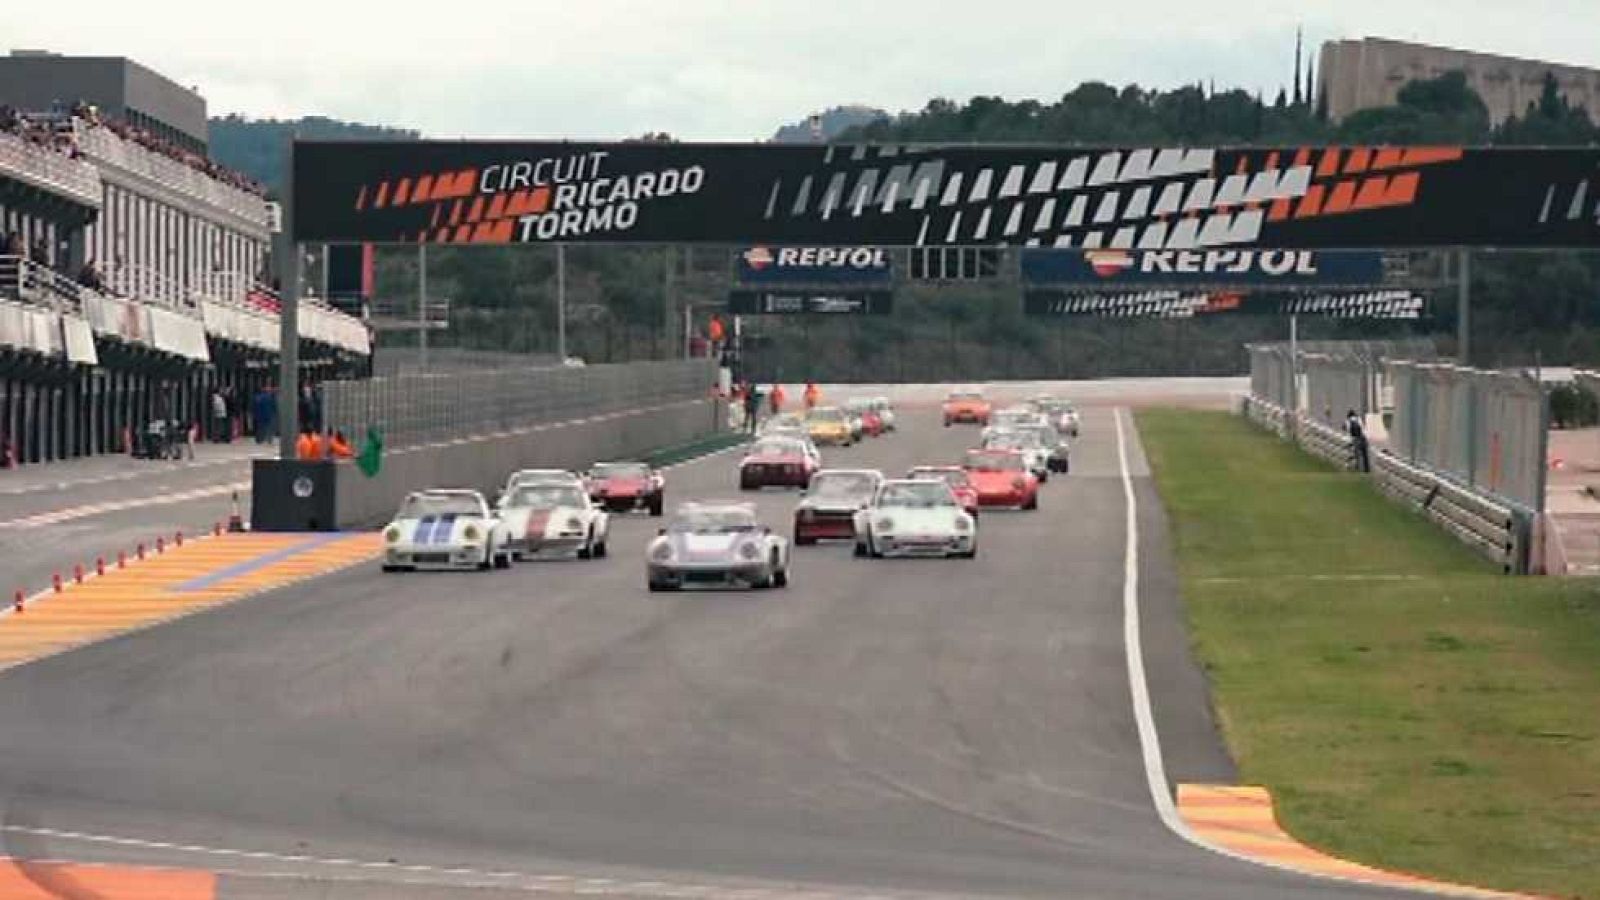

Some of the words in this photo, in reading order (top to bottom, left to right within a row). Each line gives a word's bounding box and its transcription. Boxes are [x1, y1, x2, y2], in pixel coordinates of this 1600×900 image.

[479, 151, 608, 193] CIRCUIT
[554, 165, 705, 210] RICARDO
[519, 202, 638, 242] TORMO
[776, 247, 887, 267] REPSOL
